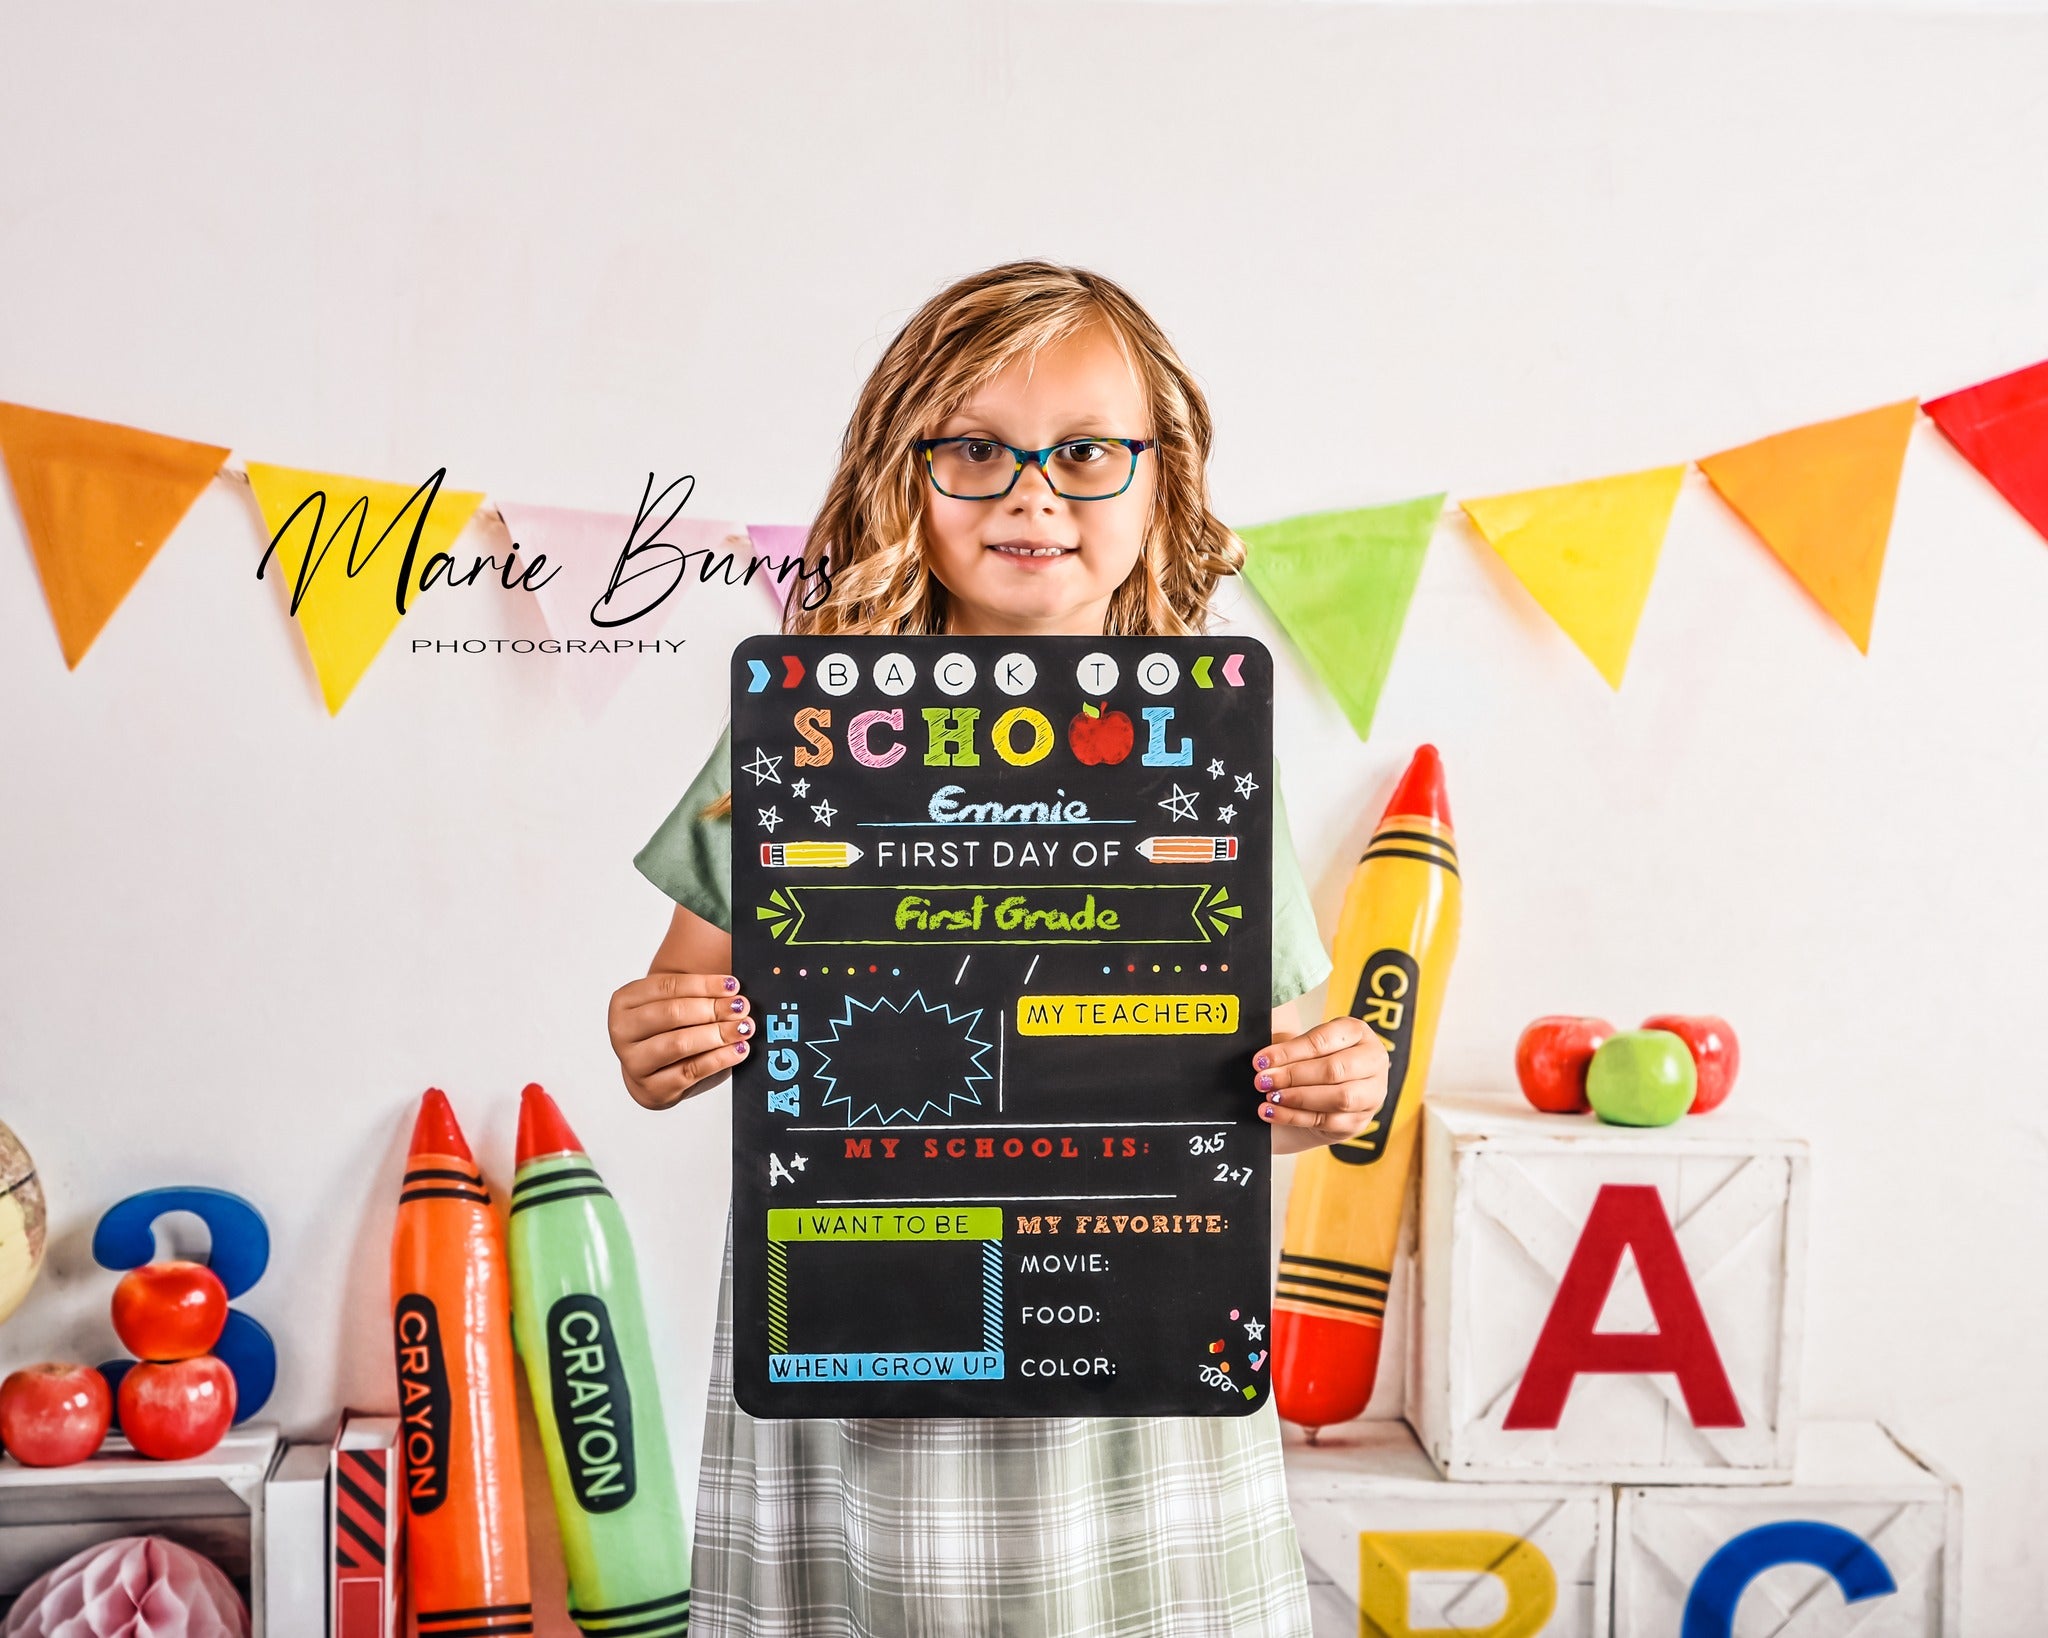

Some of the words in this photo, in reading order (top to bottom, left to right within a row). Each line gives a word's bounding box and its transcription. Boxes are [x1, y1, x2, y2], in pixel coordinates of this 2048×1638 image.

[827, 660, 1026, 689] BACK
[1088, 660, 1171, 689] TO
[927, 784, 1092, 824] Emmie
[878, 841, 980, 868] FIRST
[993, 841, 1059, 868] DAY
[1072, 841, 1121, 867] OF
[894, 894, 989, 931] First
[994, 893, 1121, 932] Grade
[1026, 1003, 1064, 1025] MY
[766, 1002, 800, 1118] AGE:
[844, 1138, 900, 1159] MY
[924, 1137, 1079, 1159] SCHOOL
[1102, 1137, 1149, 1158] IS:
[769, 1152, 809, 1187] A+
[1213, 1163, 1253, 1187] 2+7
[797, 1216, 804, 1235] I
[811, 1215, 884, 1235] WANT
[893, 1215, 926, 1234] TO
[935, 1215, 969, 1234] BE
[1016, 1215, 1062, 1235] MY
[1075, 1214, 1229, 1234] FAVORITE:
[1020, 1253, 1109, 1273] MOVIE:
[1022, 1305, 1100, 1325] FOOD:
[1502, 1183, 1746, 1431] A
[771, 1357, 848, 1378] WHEN
[857, 1358, 864, 1377] I
[871, 1356, 954, 1377] GROW
[963, 1356, 998, 1376] UP
[1020, 1357, 1116, 1377] COLOR:
[399, 1310, 439, 1498] CRAYON
[558, 1309, 626, 1498] CRAYON
